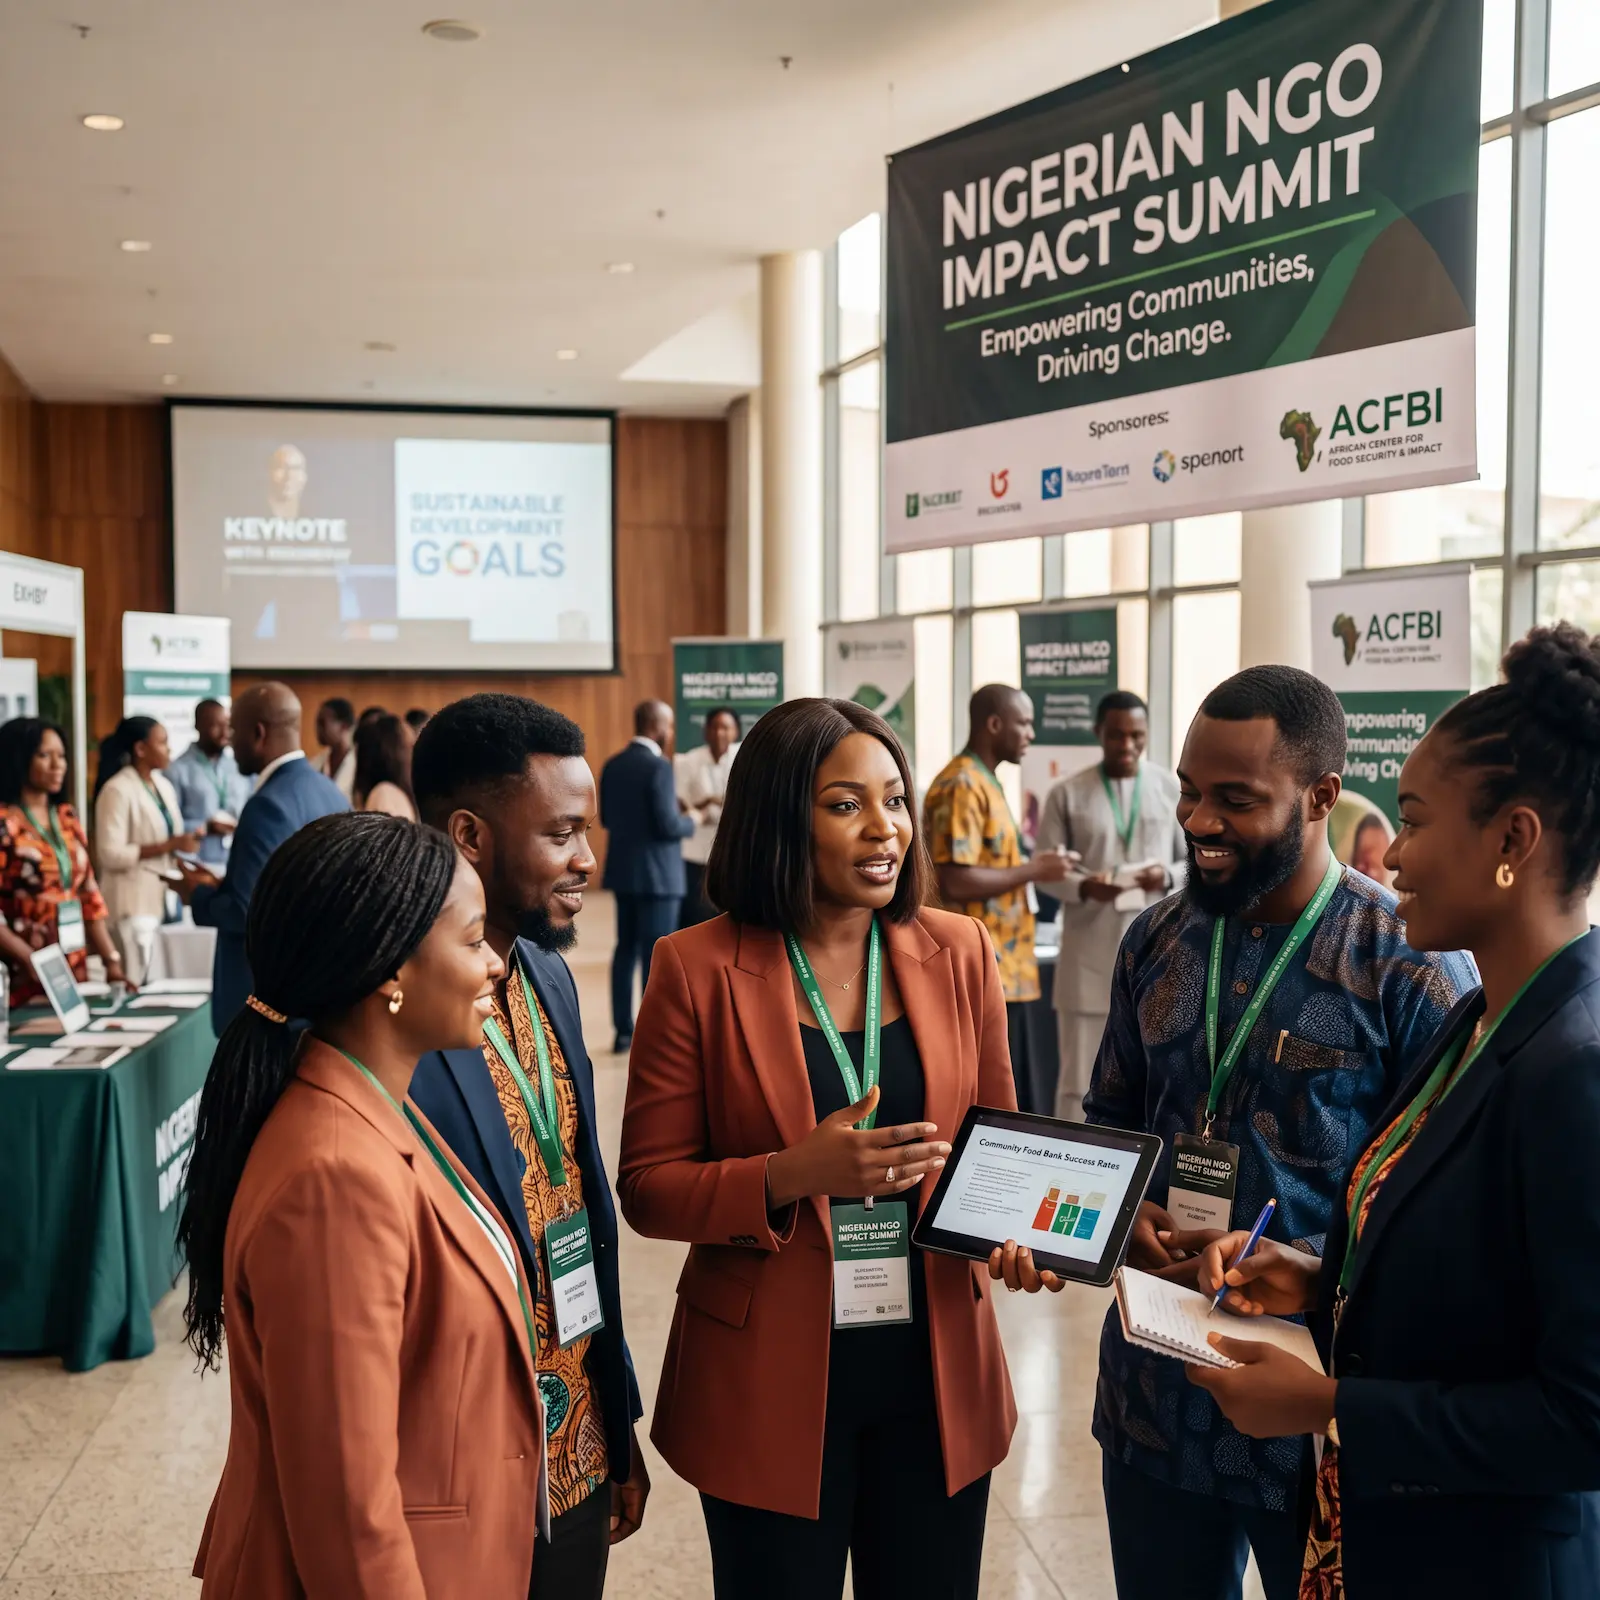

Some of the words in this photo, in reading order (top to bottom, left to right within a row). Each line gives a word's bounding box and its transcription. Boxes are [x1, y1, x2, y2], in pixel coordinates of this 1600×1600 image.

[943, 101, 1204, 247] NIGERIAN
[1226, 43, 1383, 156] NGO
[943, 208, 1120, 309] IMPACT
[1133, 127, 1375, 254] SUMMIT
[980, 301, 1122, 357] Empowering
[1128, 252, 1315, 320] Communities,
[1037, 343, 1120, 383] Driving
[1125, 319, 1232, 362] Change.
[1329, 387, 1443, 440] ACFBI
[1328, 442, 1367, 455] AFRICAN
[1368, 436, 1403, 449] CENTER
[1405, 433, 1424, 444] FOR
[1328, 455, 1354, 467] FOOD
[1355, 449, 1398, 463] SECURITY
[1399, 448, 1406, 457] &
[224, 517, 348, 542] KEYNOTE
[412, 539, 566, 578] GOALS
[1366, 610, 1442, 642] ACFBI
[979, 1138, 1022, 1154] Community
[1022, 1146, 1043, 1157] Food
[1043, 1149, 1063, 1161] Bank
[1063, 1153, 1096, 1166] Success
[1097, 1159, 1121, 1170] Rates
[1177, 1152, 1213, 1167] NIGERIAN
[1212, 1159, 1231, 1171] NGO
[1202, 1167, 1232, 1180] SUMMIT
[838, 1223, 879, 1233] NIGERIAN
[879, 1220, 901, 1230] NGO
[838, 1232, 869, 1242] IMPACT
[869, 1230, 902, 1240] SUMMIT
